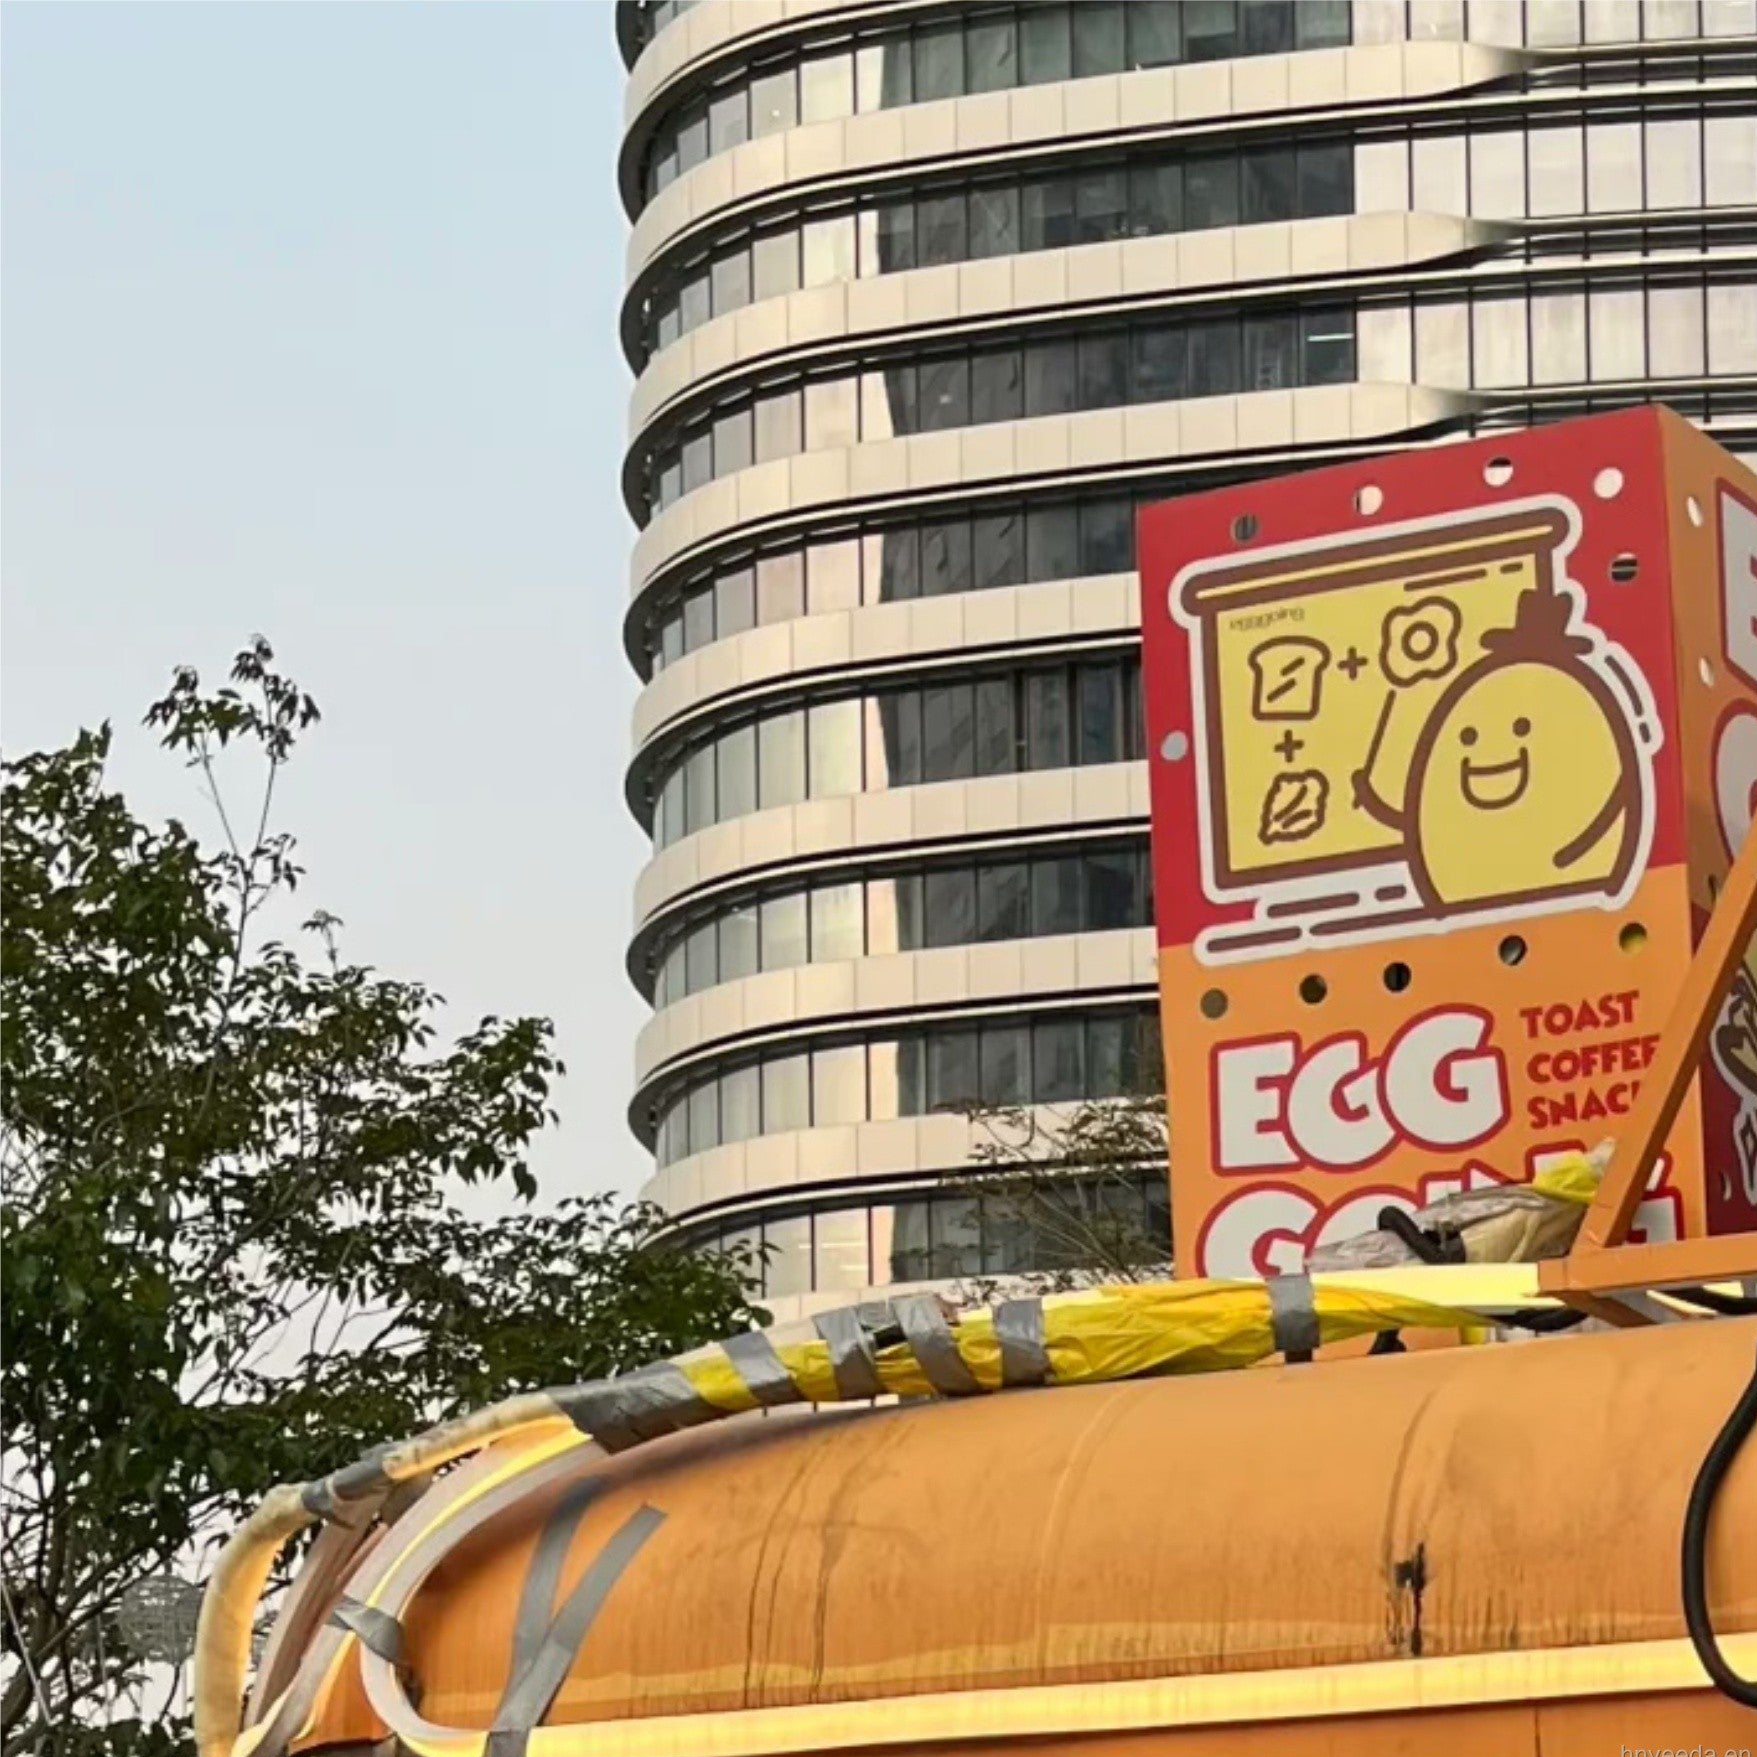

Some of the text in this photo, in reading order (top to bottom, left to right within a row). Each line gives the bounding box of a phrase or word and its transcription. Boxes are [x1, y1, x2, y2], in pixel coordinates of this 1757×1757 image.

[1519, 988, 1641, 1039] TOAST
[1214, 1007, 1506, 1172] EGG
[1526, 1079, 1641, 1130] SNAC
